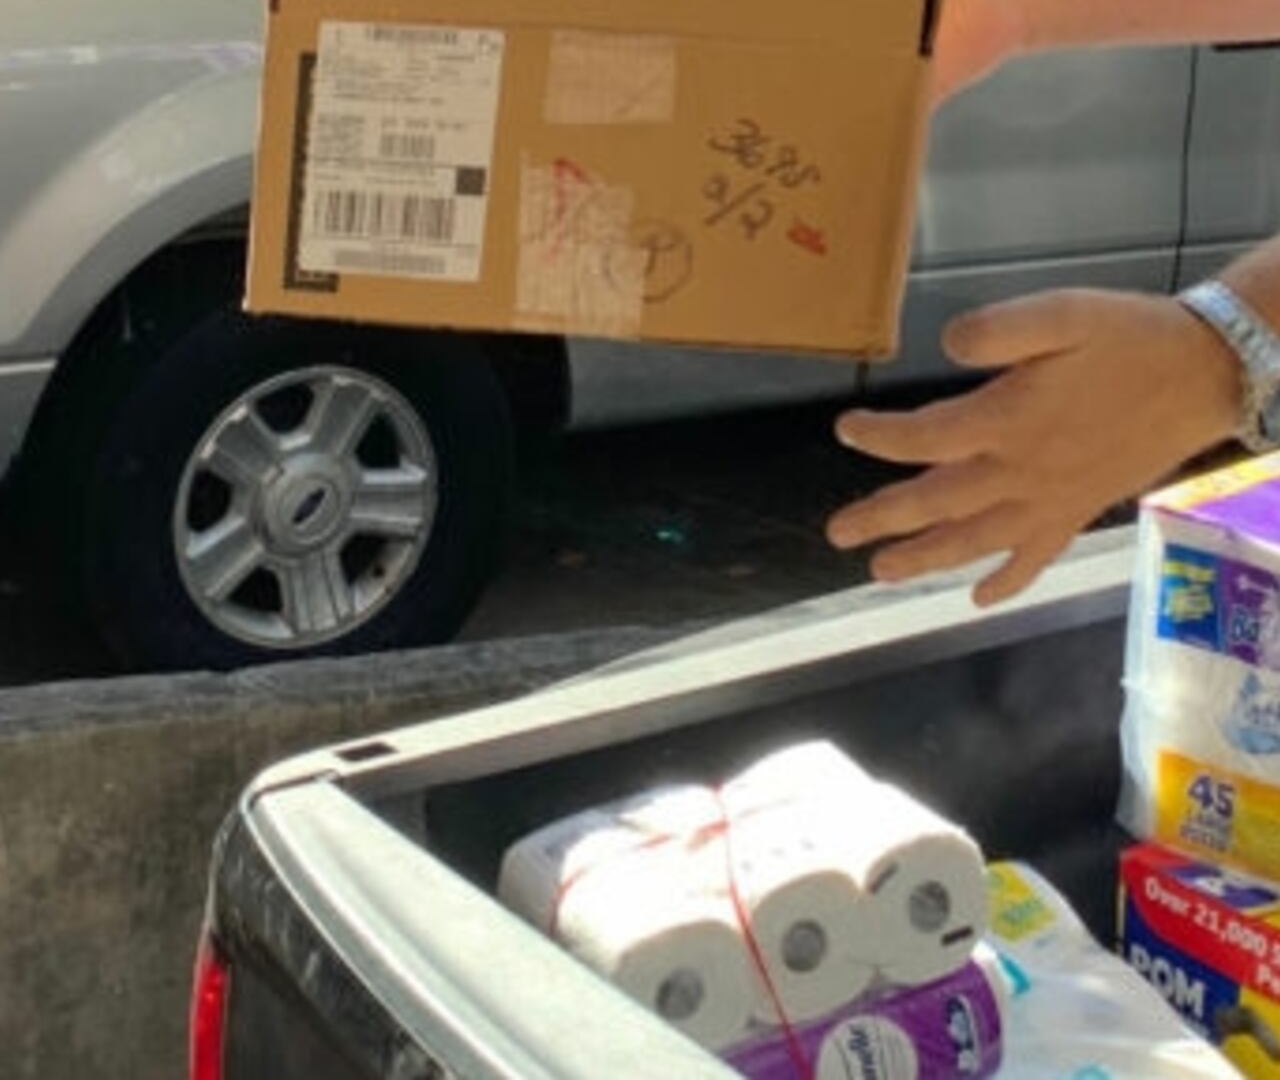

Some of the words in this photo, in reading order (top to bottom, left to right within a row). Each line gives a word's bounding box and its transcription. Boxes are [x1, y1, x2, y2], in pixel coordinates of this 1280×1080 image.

[1188, 775, 1235, 818] 45
[1144, 877, 1191, 915] Over
[1194, 902, 1268, 958] 21,000
[1128, 944, 1206, 1018] POM
